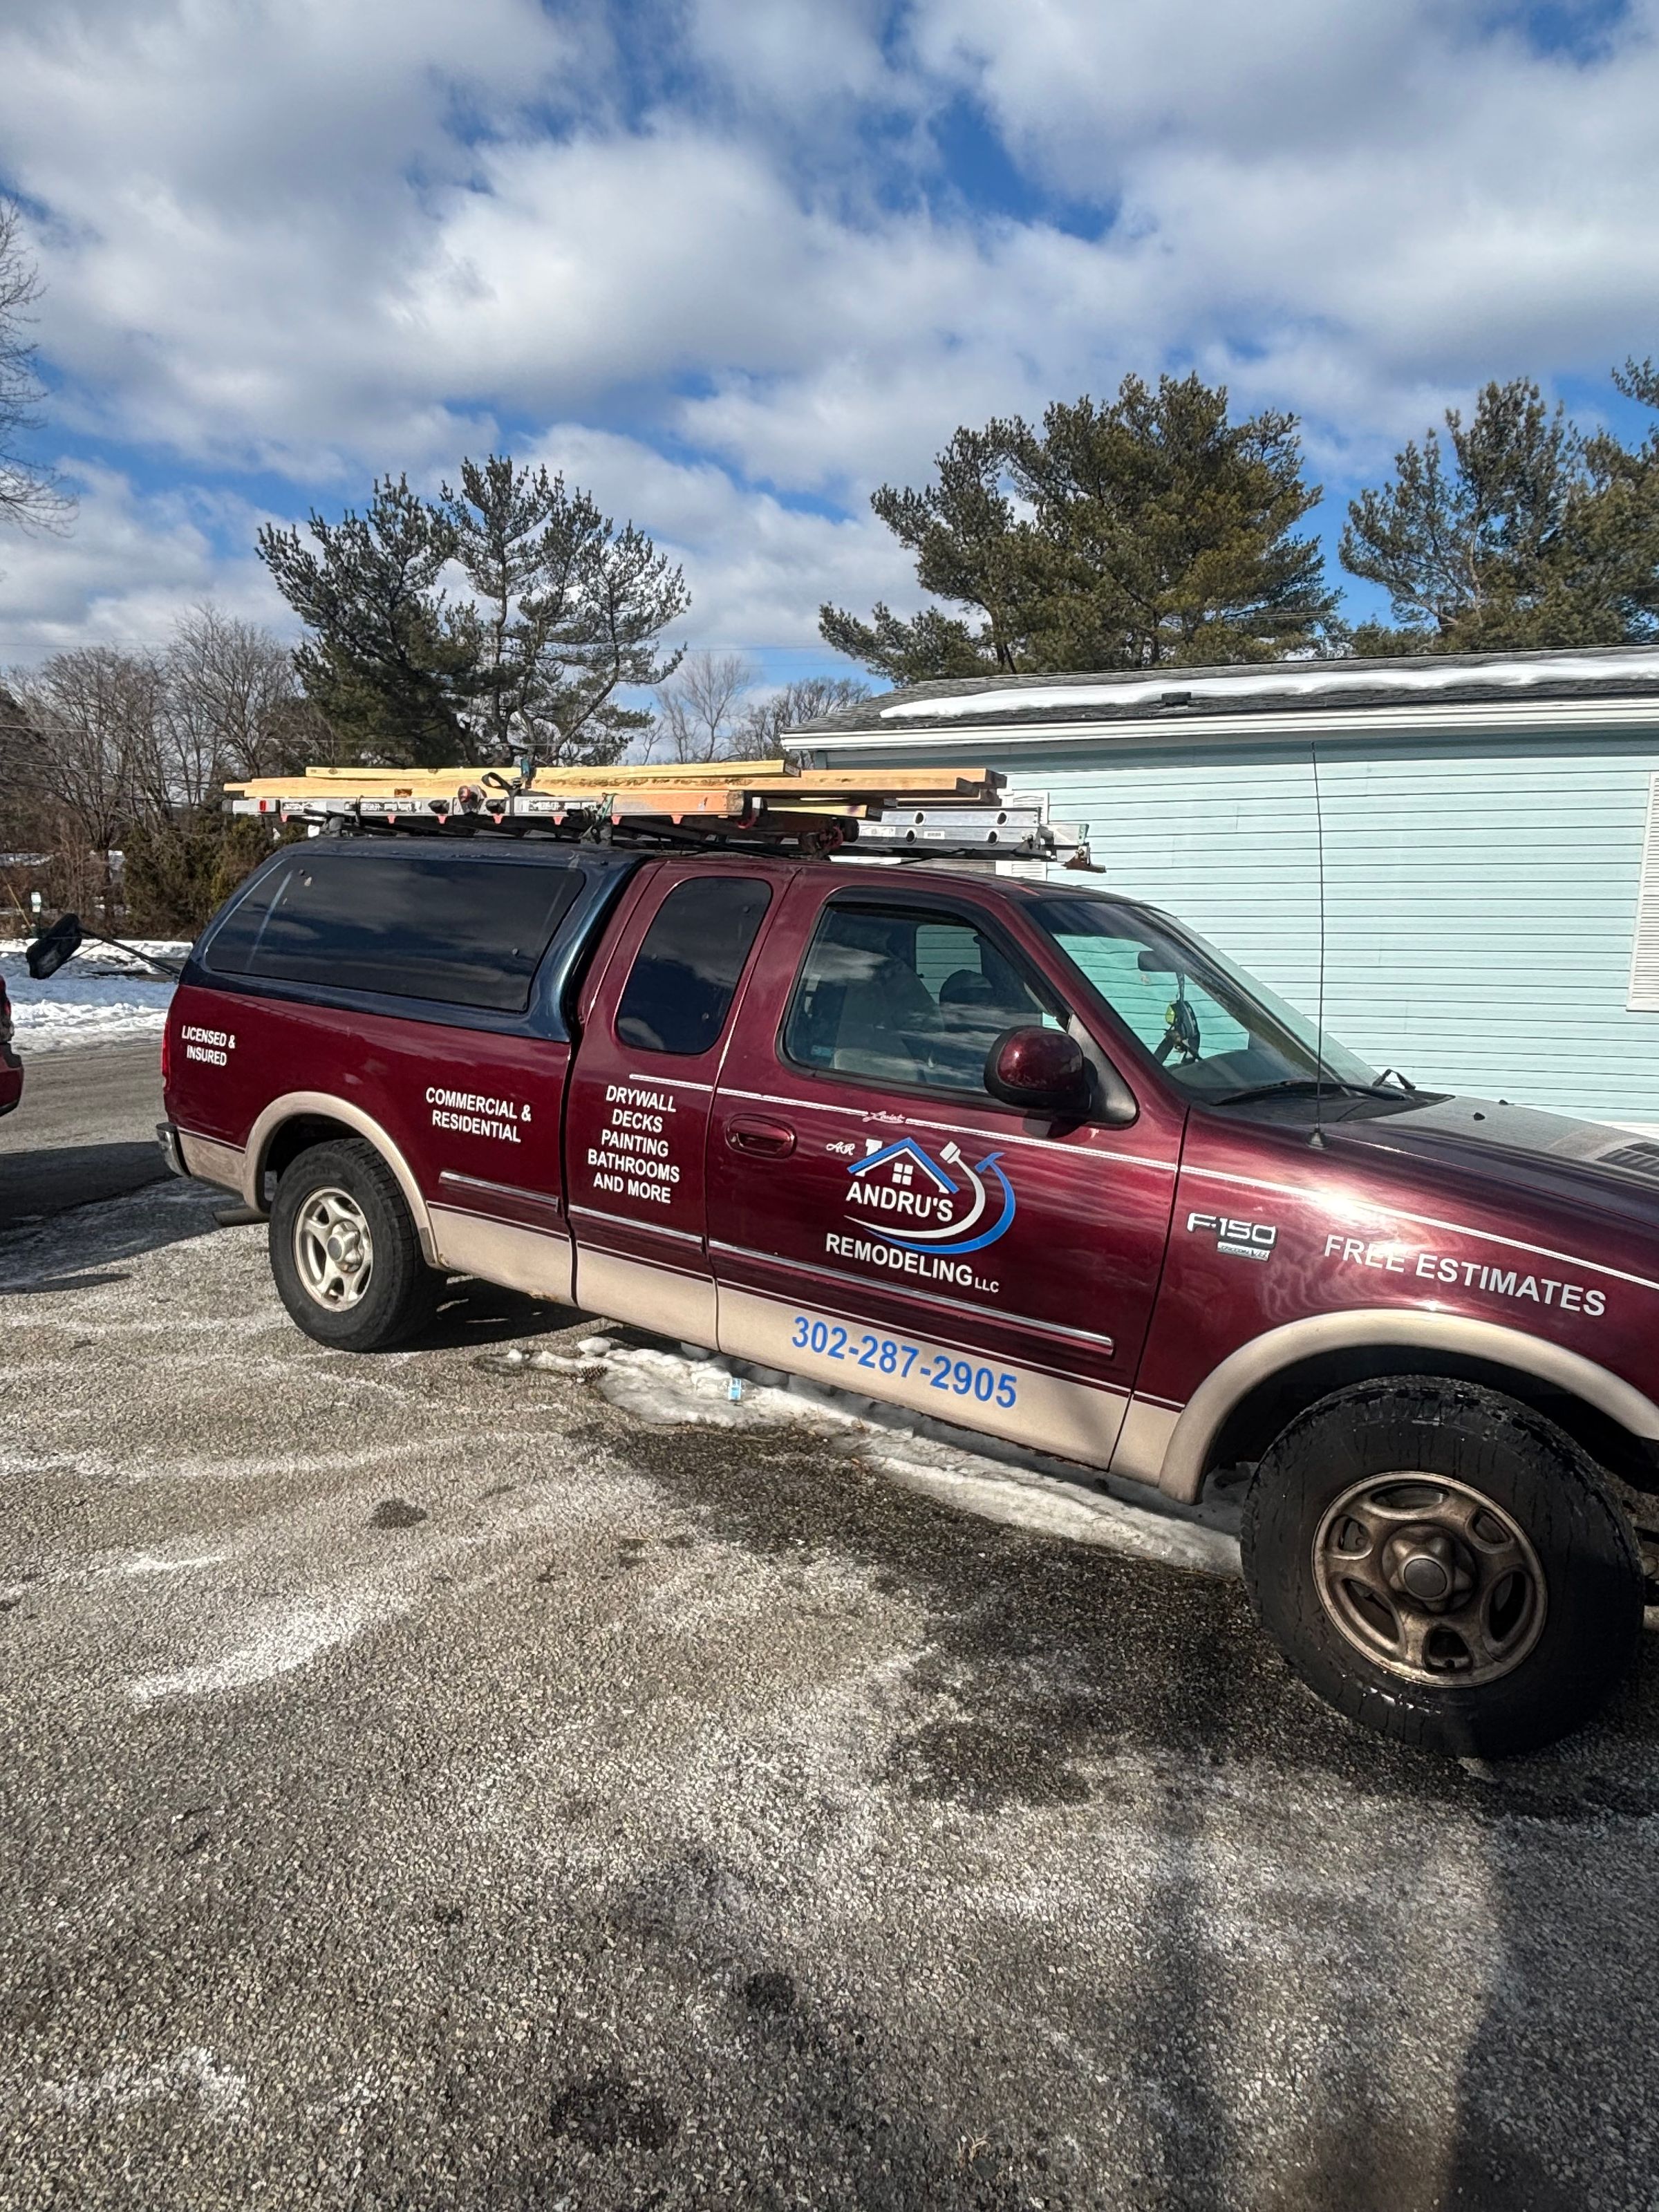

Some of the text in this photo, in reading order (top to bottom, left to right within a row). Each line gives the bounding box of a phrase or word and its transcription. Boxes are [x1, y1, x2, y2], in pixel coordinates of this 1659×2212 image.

[182, 1026, 236, 1049] LICENSED &
[187, 1044, 227, 1066] INSURED
[426, 1087, 532, 1121] COMMERCIAL &
[606, 1085, 677, 1113] DRYWALL
[432, 1110, 521, 1143] RESIDENTIAL
[612, 1109, 663, 1133] DECKS
[601, 1130, 668, 1157] PAINTING
[588, 1149, 680, 1183] BATHROOMS
[593, 1172, 671, 1203] AND MORE
[845, 1182, 953, 1222] ANDRU'S
[1187, 1212, 1276, 1244] F-150
[826, 1233, 1000, 1293] REMODELING LLC
[1324, 1234, 1606, 1316] FREE ESTIMATES
[792, 1316, 1018, 1408] 302-287-2905
